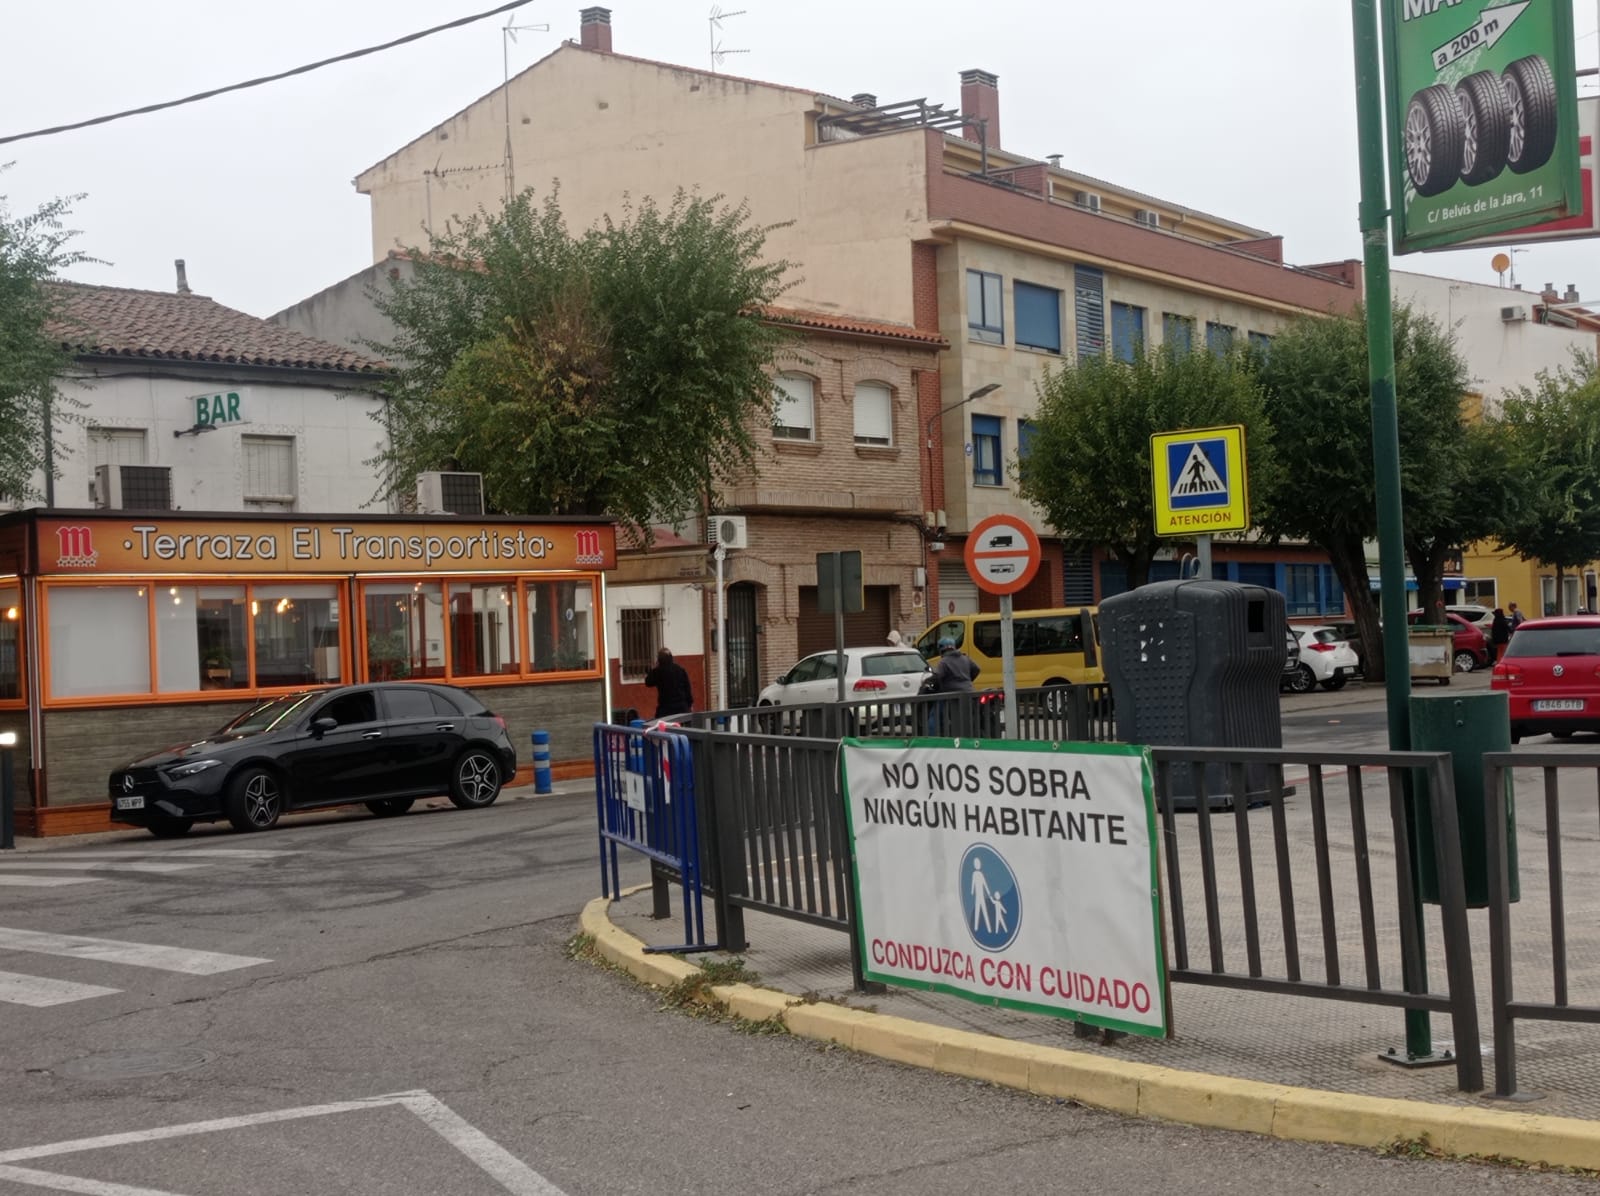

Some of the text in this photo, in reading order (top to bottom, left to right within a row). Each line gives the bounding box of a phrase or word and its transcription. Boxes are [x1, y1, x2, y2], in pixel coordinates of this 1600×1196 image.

[1438, 19, 1499, 65] a 200 m
[1427, 185, 1543, 223] C/ Belvís de la Jara, 11
[196, 392, 241, 425] BAR
[1170, 511, 1231, 526] ATENCIÓN
[292, 526, 321, 560] El
[882, 762, 1091, 801] NO NOS SOBRA
[864, 791, 1127, 845] NINGÚN HABITANTE
[872, 938, 1151, 1014] CONDUZCA CON CUIDADO
